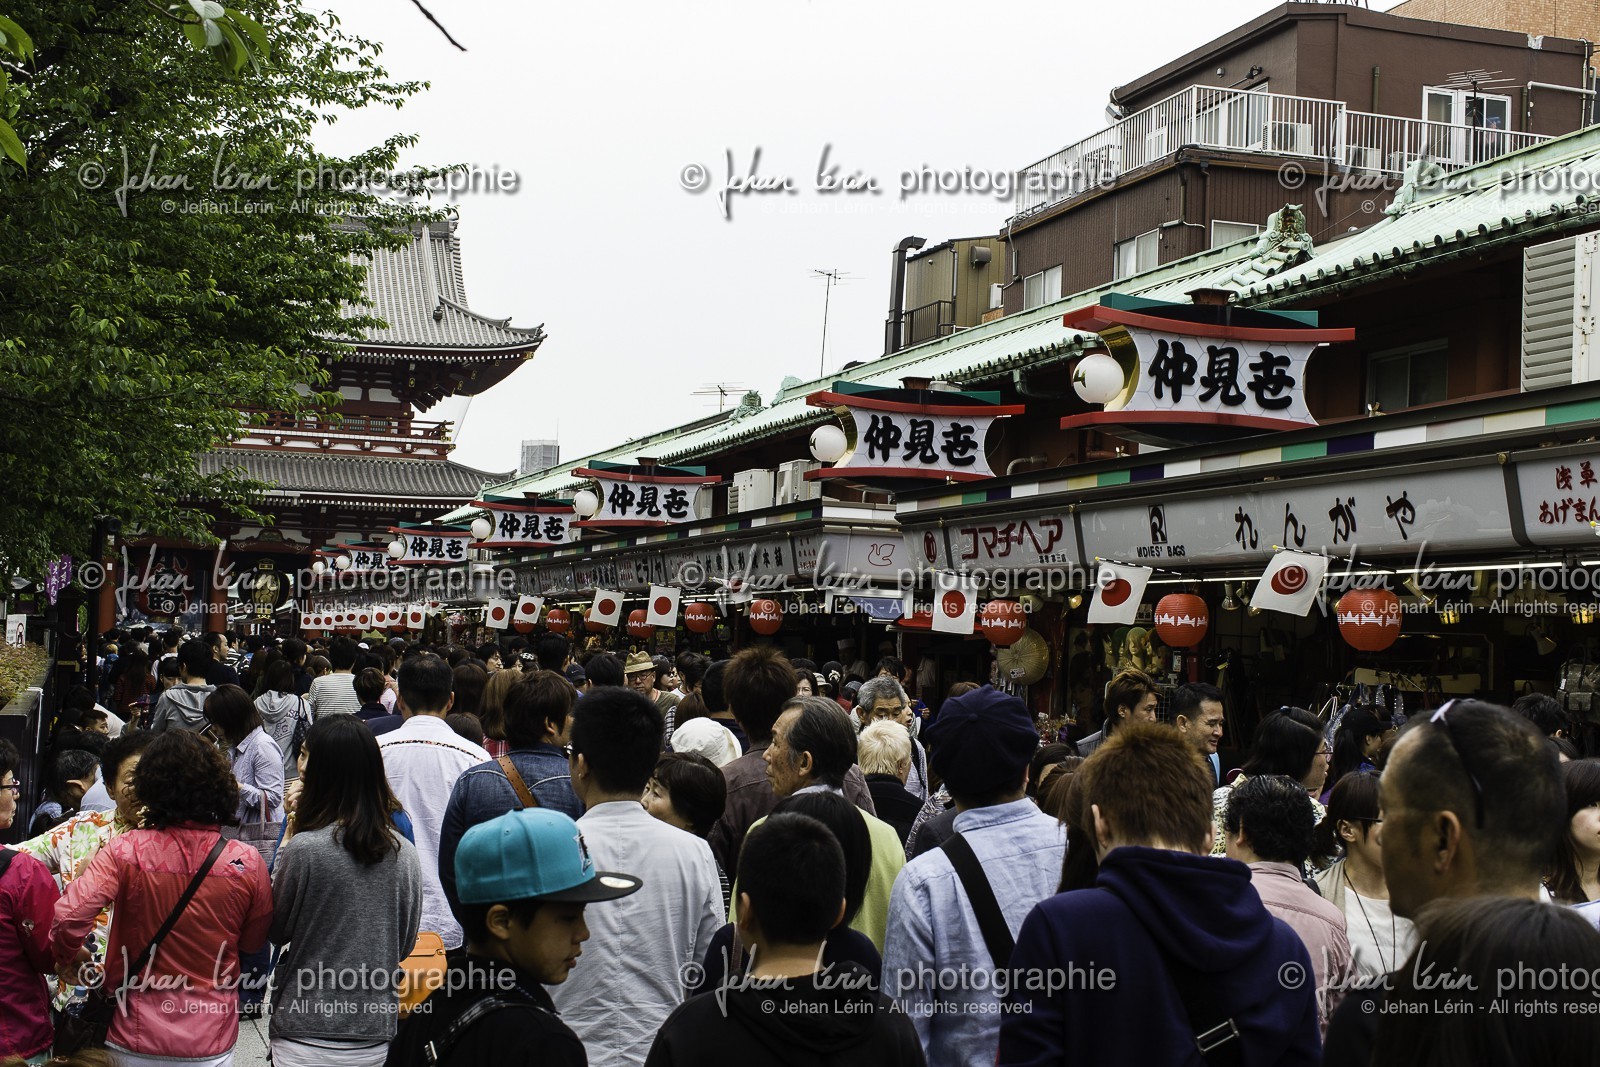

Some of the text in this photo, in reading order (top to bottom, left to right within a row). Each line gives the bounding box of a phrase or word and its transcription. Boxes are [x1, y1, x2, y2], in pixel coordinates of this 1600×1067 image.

[1555, 460, 1598, 491] 浅草
[1234, 490, 1416, 550] れんがや
[961, 518, 1063, 560] コマチヘア
[1167, 544, 1186, 557] BAGS
